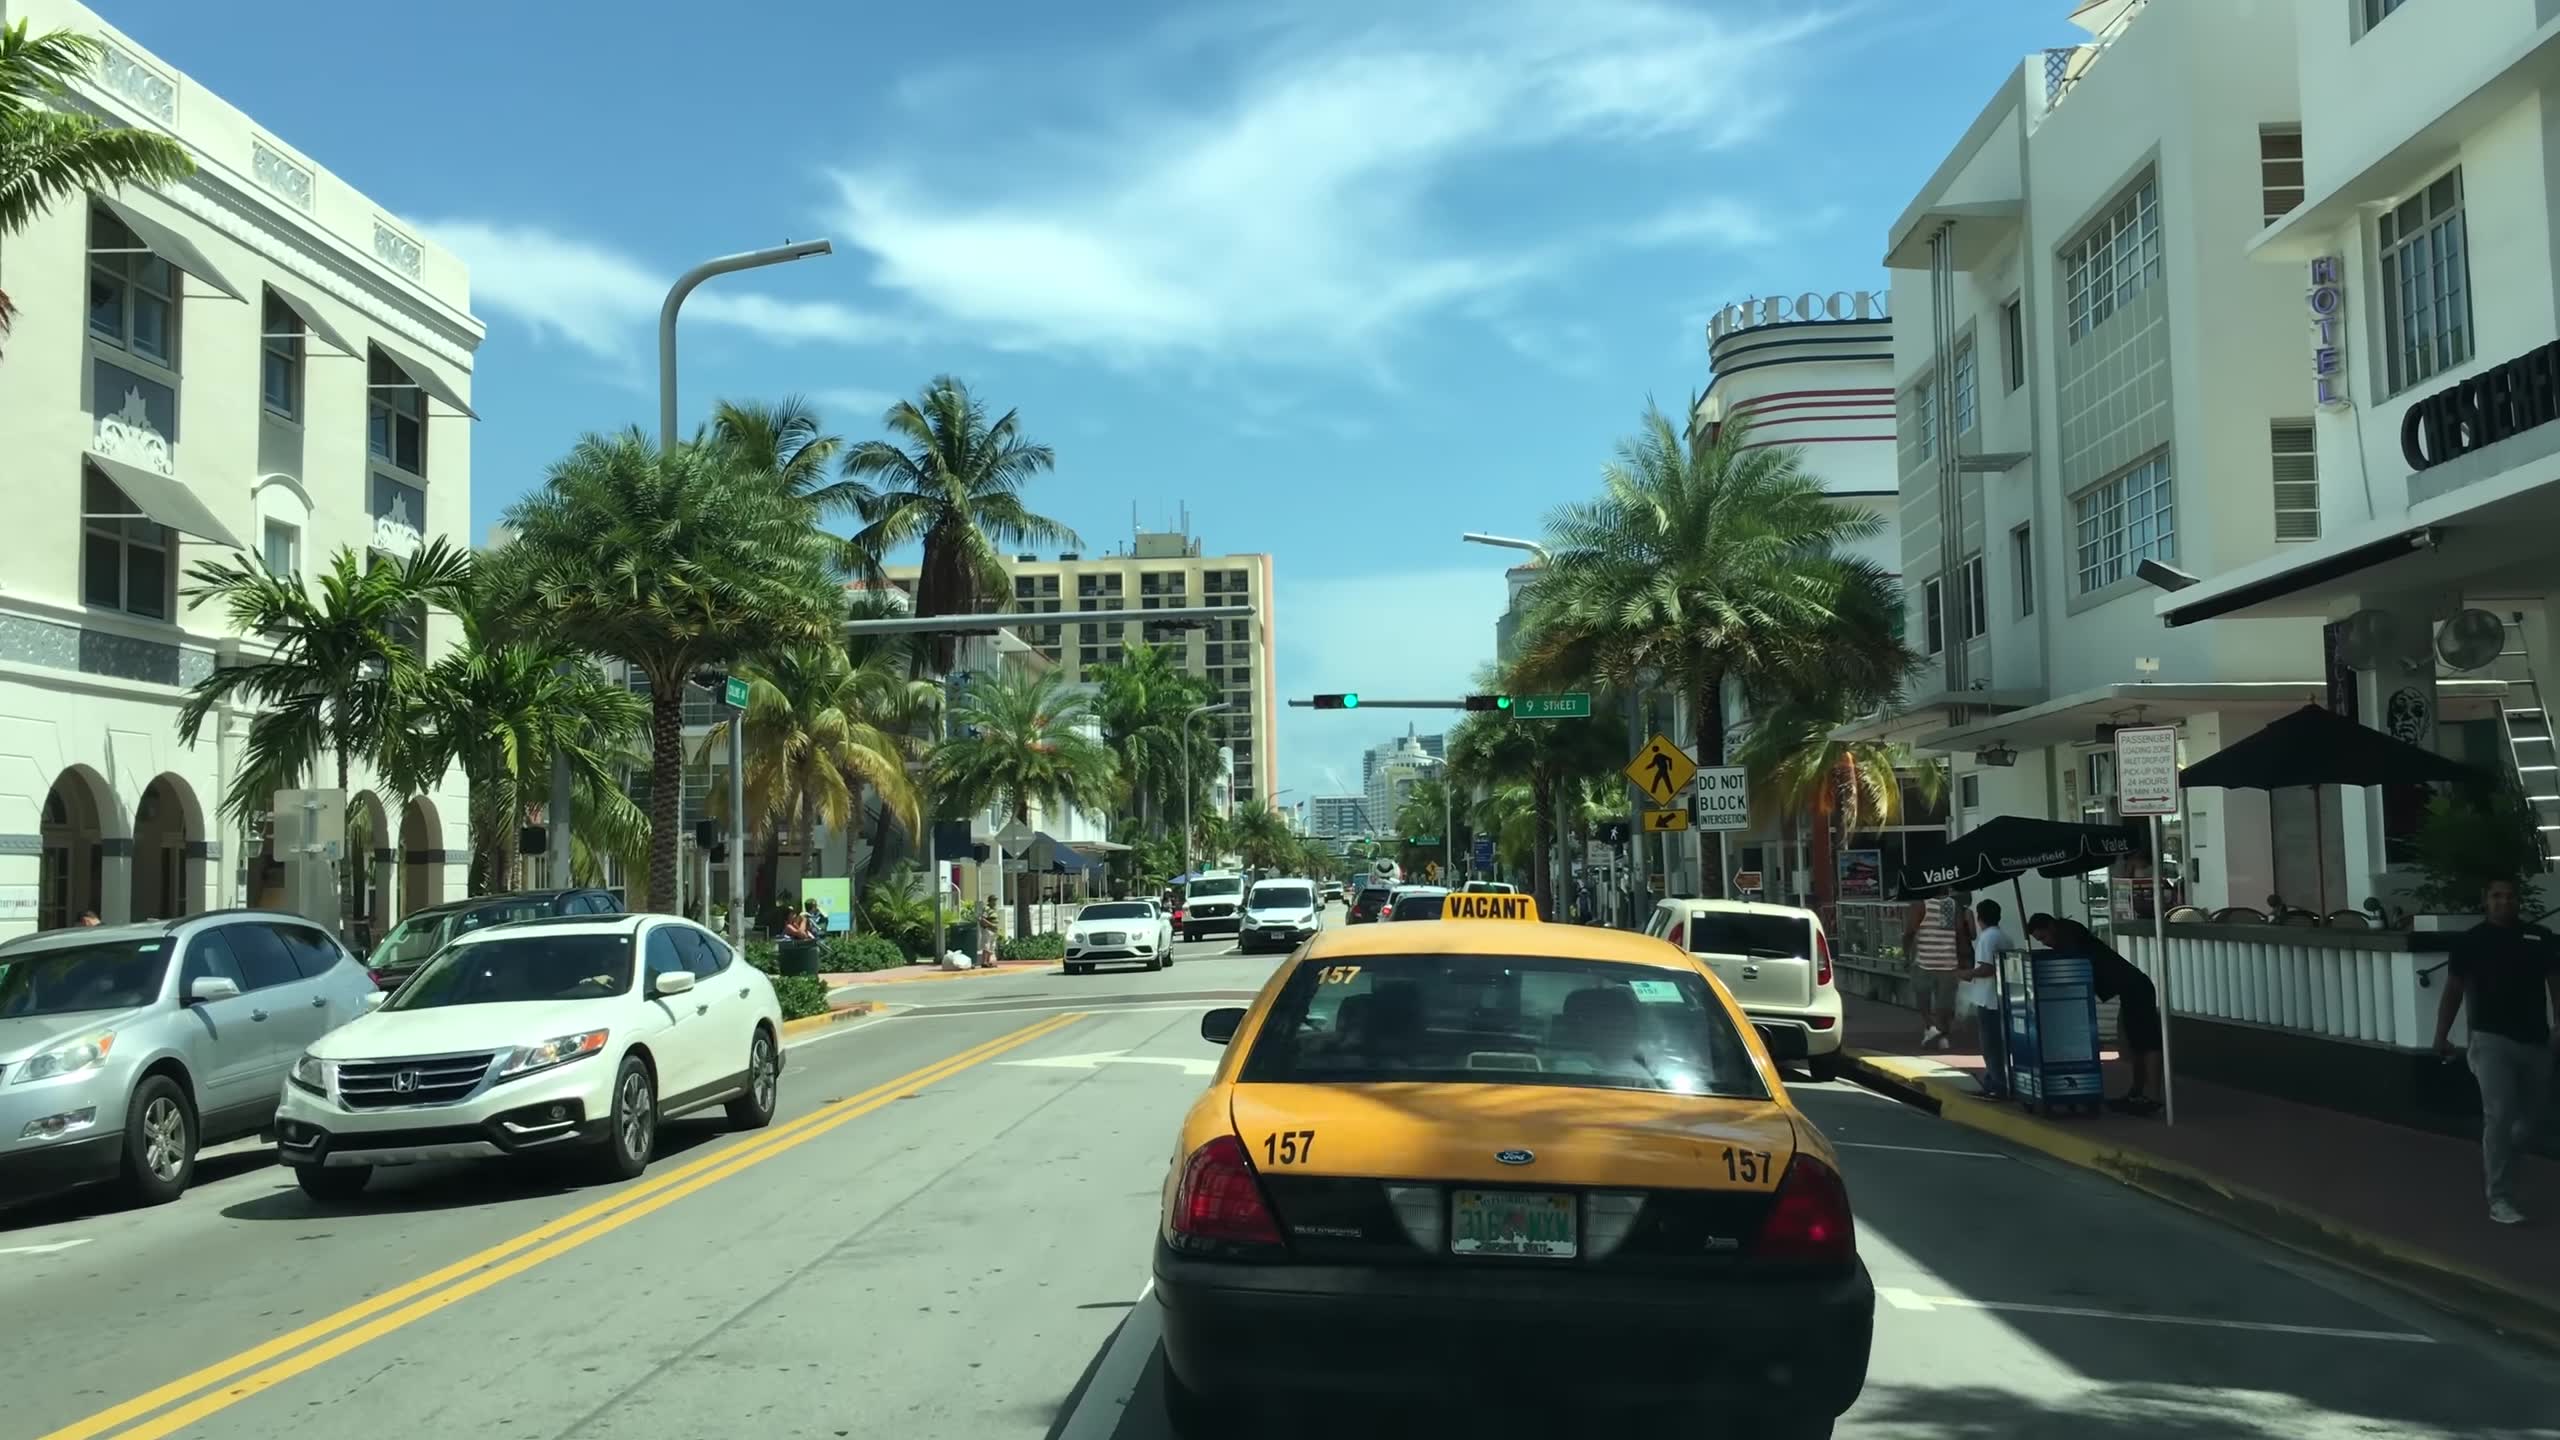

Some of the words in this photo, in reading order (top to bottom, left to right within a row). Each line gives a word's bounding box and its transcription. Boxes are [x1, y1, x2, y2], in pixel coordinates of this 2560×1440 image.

[2312, 256, 2337, 404] HOTEL
[1526, 700, 1534, 712] 9
[1543, 700, 1577, 711] STREET
[2121, 734, 2171, 744] PASSENGER
[1700, 775, 1716, 790] DO
[1721, 774, 1744, 789] NOT
[2138, 777, 2168, 785] HOURS
[1700, 795, 1746, 811] BLOCK
[1701, 814, 1747, 825] INTERSECTION
[2102, 837, 2129, 852] Valet
[2001, 850, 2066, 867] Chesterfield
[1923, 865, 1960, 884] Valet
[1450, 896, 1528, 919] VACANT
[1318, 966, 1362, 985] 157
[1264, 1130, 1315, 1165] 157
[1722, 1147, 1771, 1184] 157
